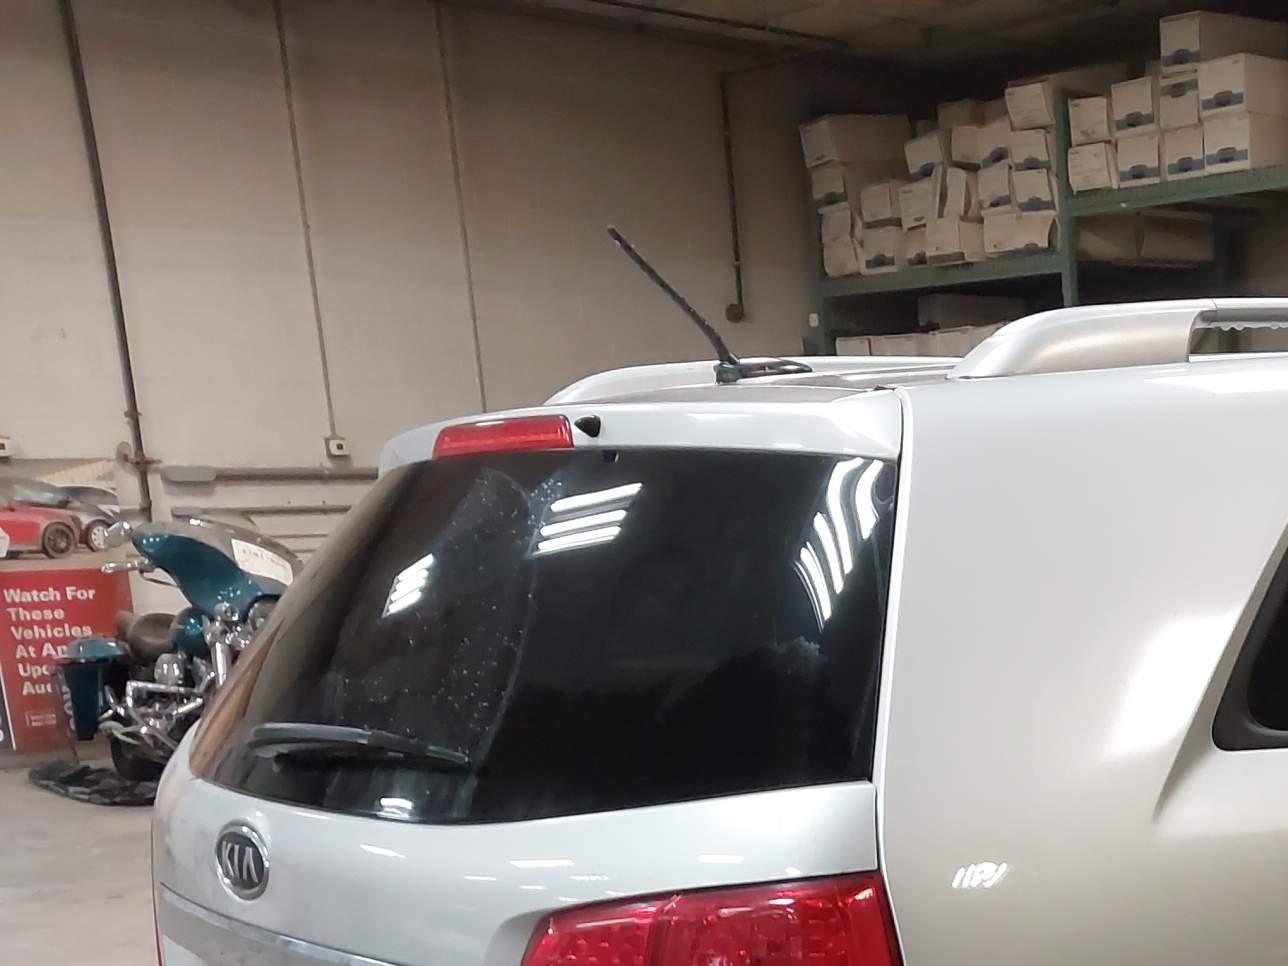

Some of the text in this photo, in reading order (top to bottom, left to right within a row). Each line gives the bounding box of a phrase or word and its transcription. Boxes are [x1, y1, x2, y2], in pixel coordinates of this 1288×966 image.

[3, 586, 96, 603] Watch For
[6, 607, 65, 621] These
[10, 624, 93, 641] Vehicles
[15, 645, 36, 659] At
[222, 841, 258, 882] KIA
